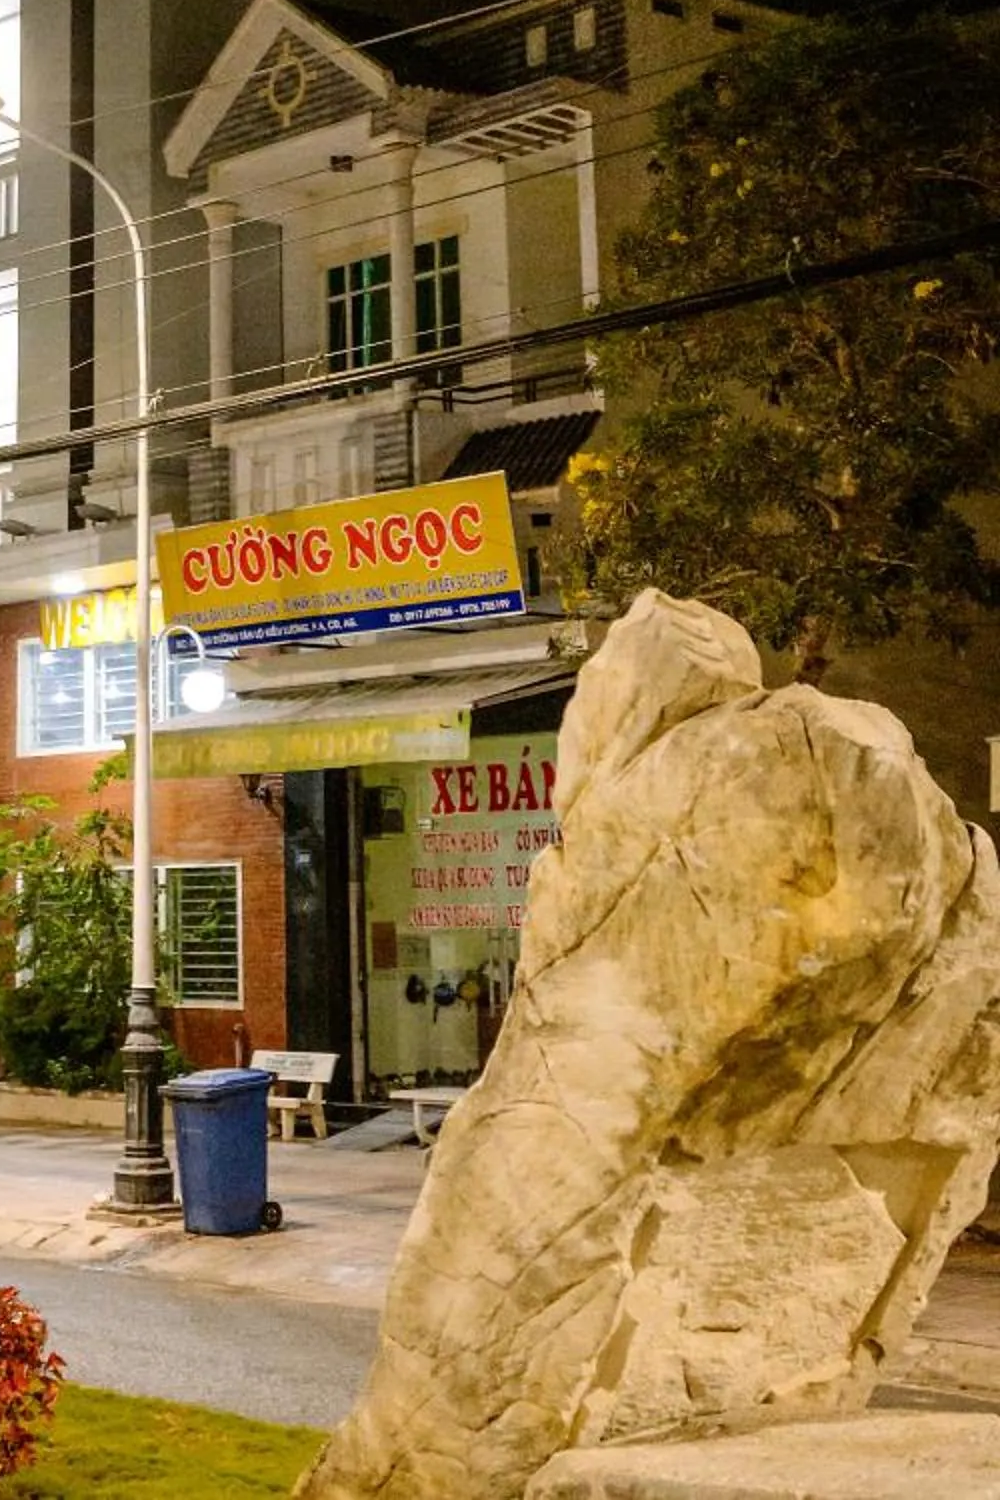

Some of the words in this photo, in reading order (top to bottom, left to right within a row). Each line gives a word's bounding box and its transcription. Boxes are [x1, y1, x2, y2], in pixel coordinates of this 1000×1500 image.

[182, 525, 334, 594] CƯỜNG
[342, 504, 485, 570] NGỌC
[431, 765, 479, 815] XE
